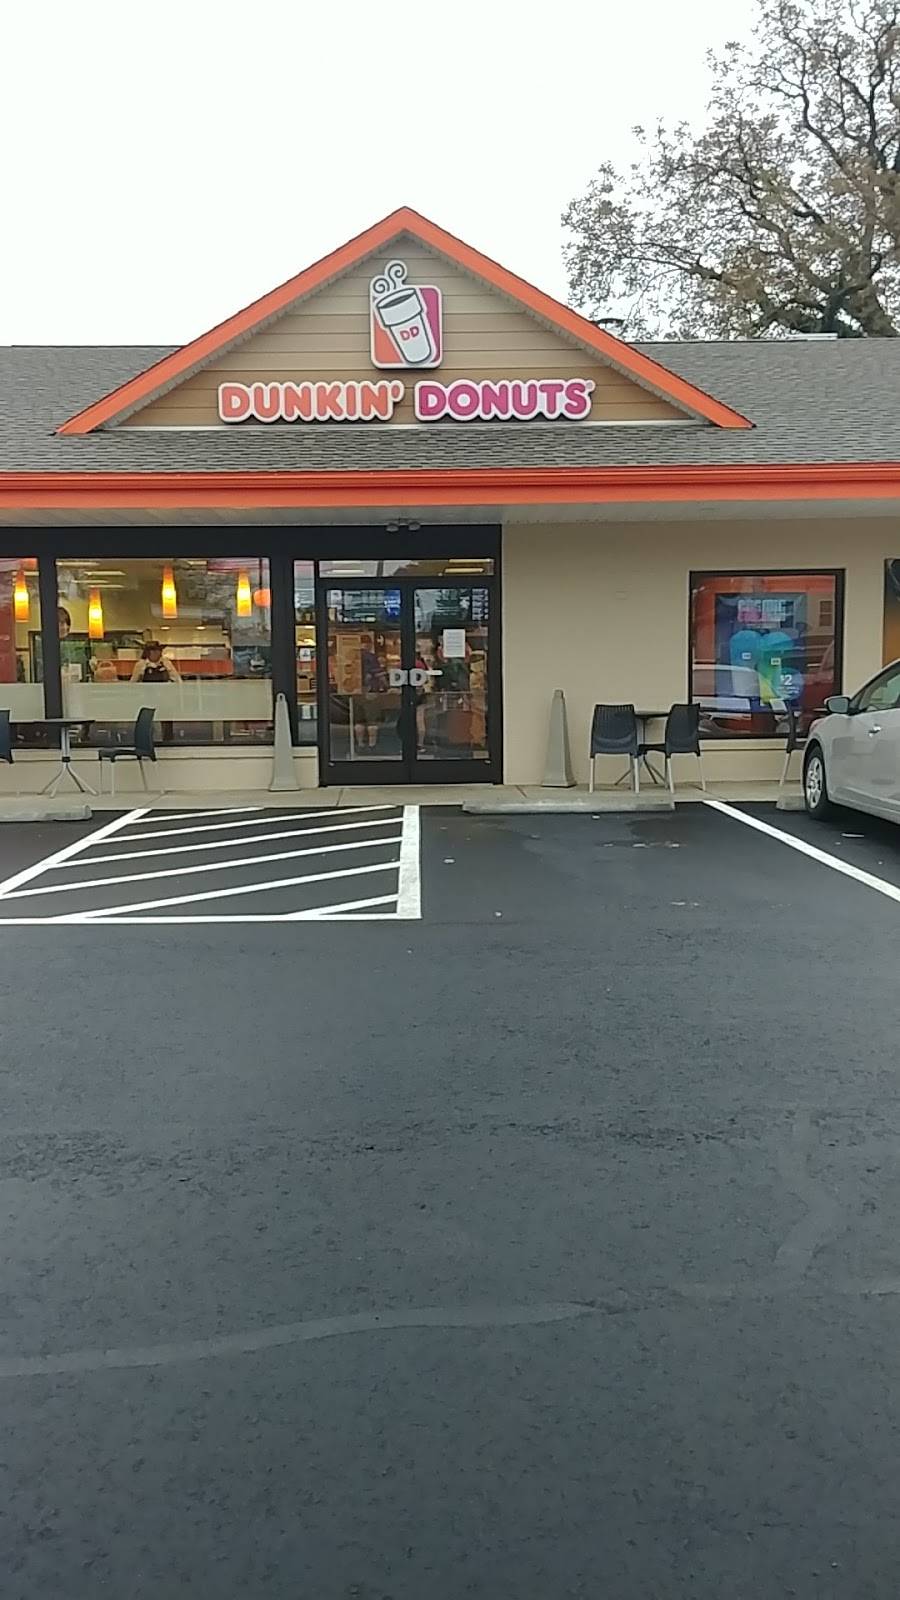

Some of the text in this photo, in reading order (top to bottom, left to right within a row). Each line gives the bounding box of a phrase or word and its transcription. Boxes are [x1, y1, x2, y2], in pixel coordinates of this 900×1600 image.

[399, 326, 420, 342] DD
[220, 381, 592, 420] DUNKIN' DONUTS
